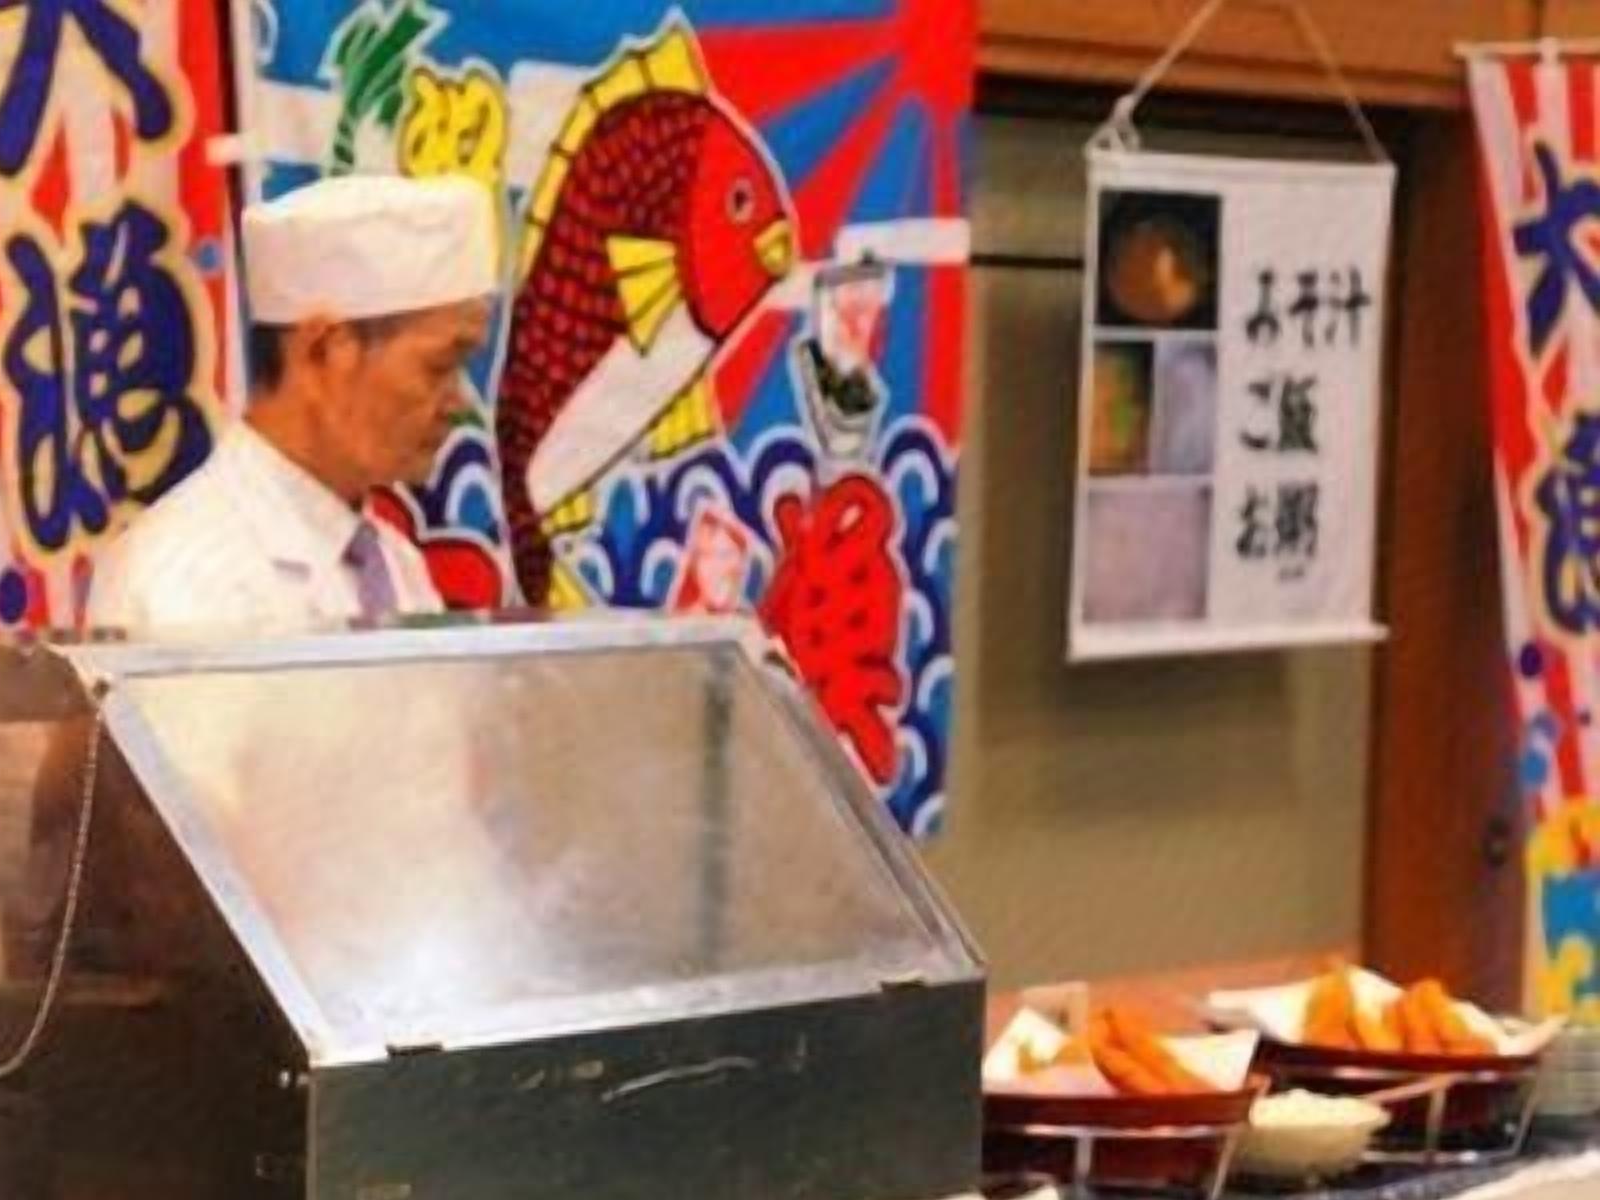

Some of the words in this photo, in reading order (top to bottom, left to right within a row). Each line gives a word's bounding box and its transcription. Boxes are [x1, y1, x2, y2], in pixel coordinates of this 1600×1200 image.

[1246, 267, 1370, 347] みそ汁
[1240, 374, 1318, 454] ご飯
